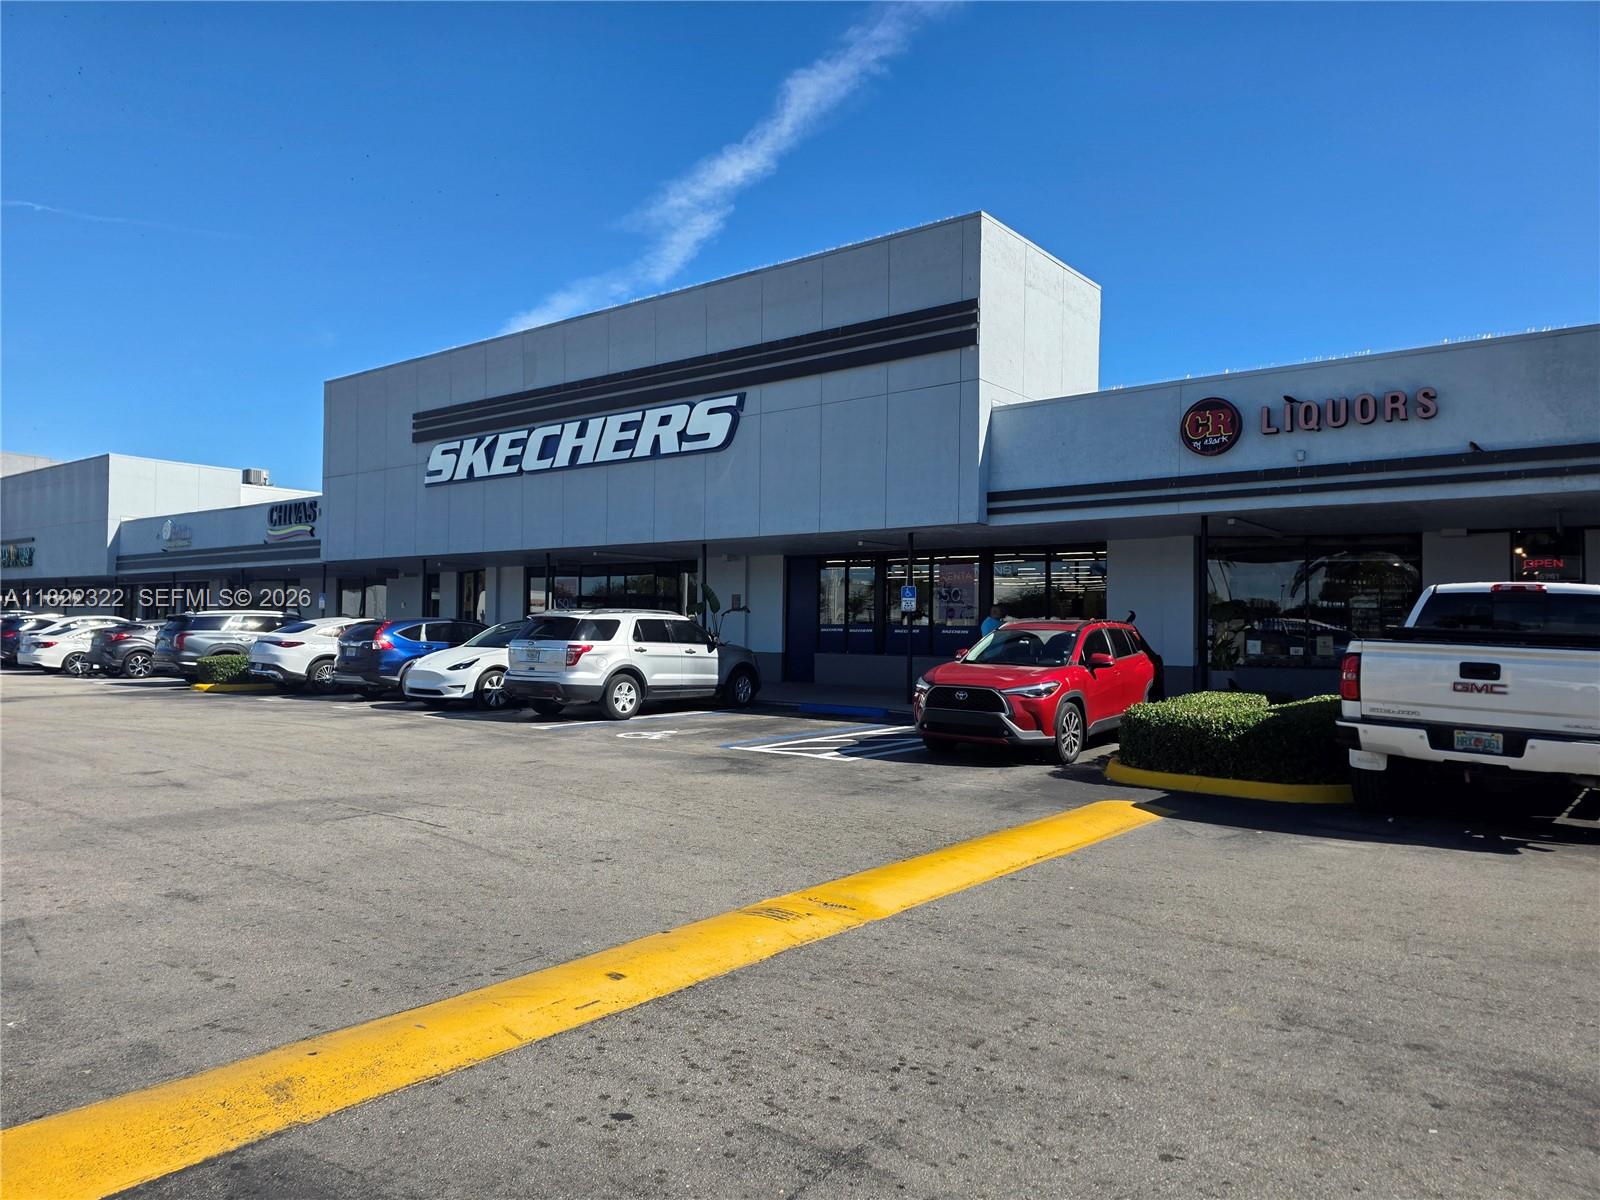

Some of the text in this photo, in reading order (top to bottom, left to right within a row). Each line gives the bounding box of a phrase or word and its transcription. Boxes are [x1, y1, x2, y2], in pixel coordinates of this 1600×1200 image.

[1185, 408, 1233, 440] CR
[1261, 386, 1438, 435] LIQUORS
[425, 392, 746, 488] SKECHERS
[268, 500, 319, 527] CHIVAS
[1523, 559, 1565, 568] OPEN
[1452, 681, 1509, 695] GMC
